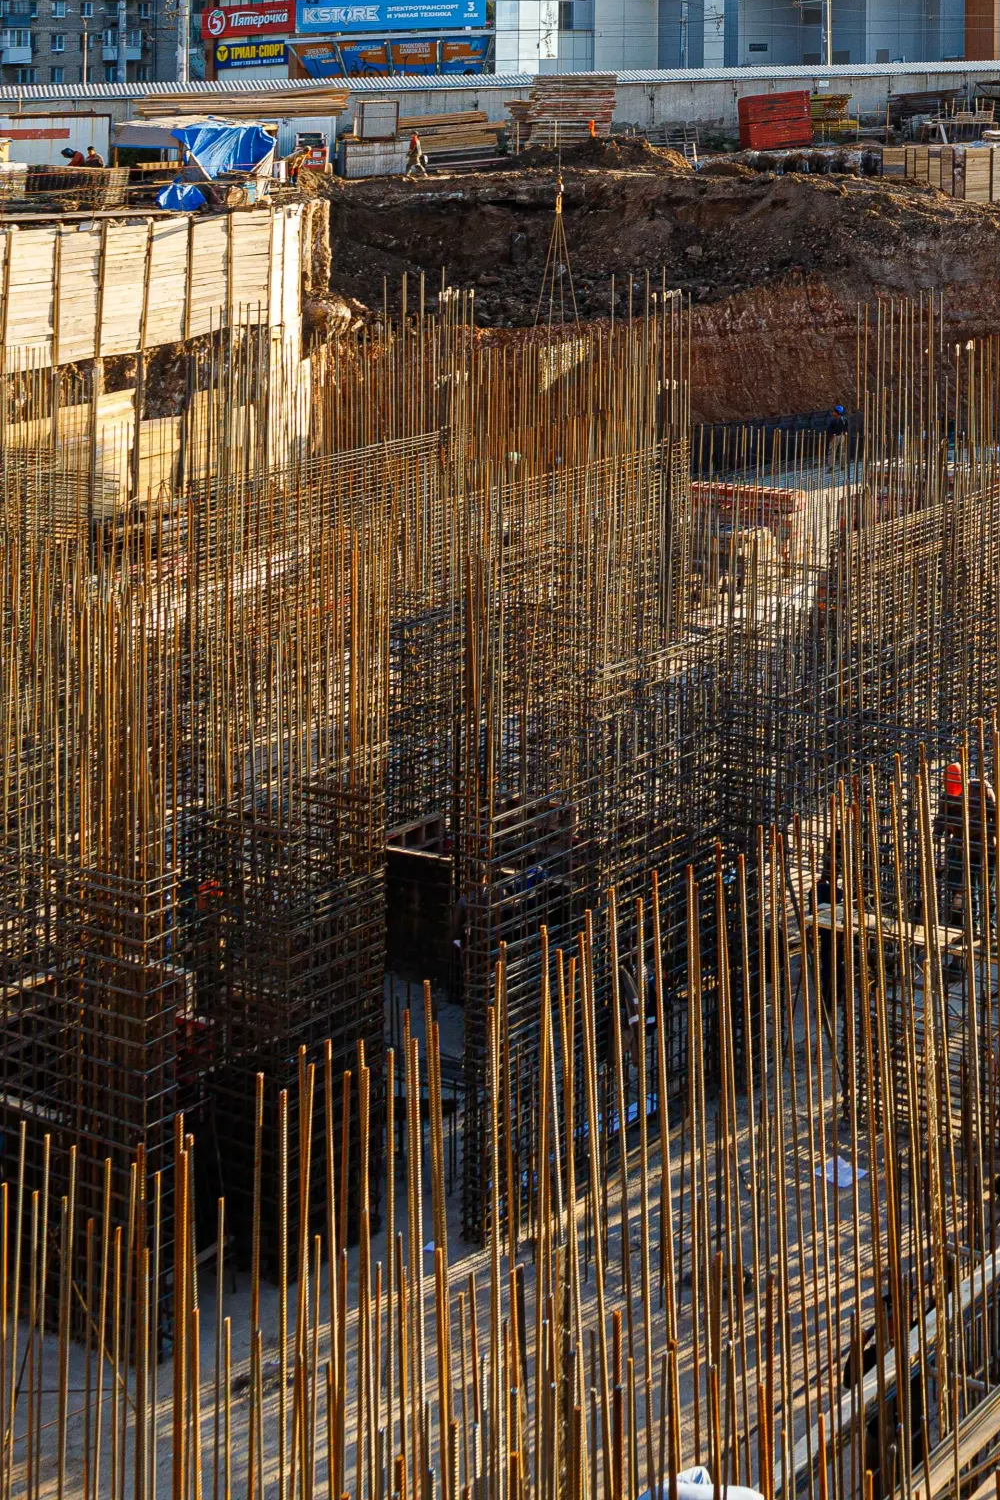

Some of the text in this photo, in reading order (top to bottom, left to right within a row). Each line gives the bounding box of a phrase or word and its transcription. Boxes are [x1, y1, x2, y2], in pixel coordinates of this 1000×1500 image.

[386, 3, 459, 12] ЭЛЕКТРОТРАНСПОРТ
[467, 1, 475, 12] 3
[228, 11, 288, 28] Пятерочка
[302, 4, 380, 24] KSTORE
